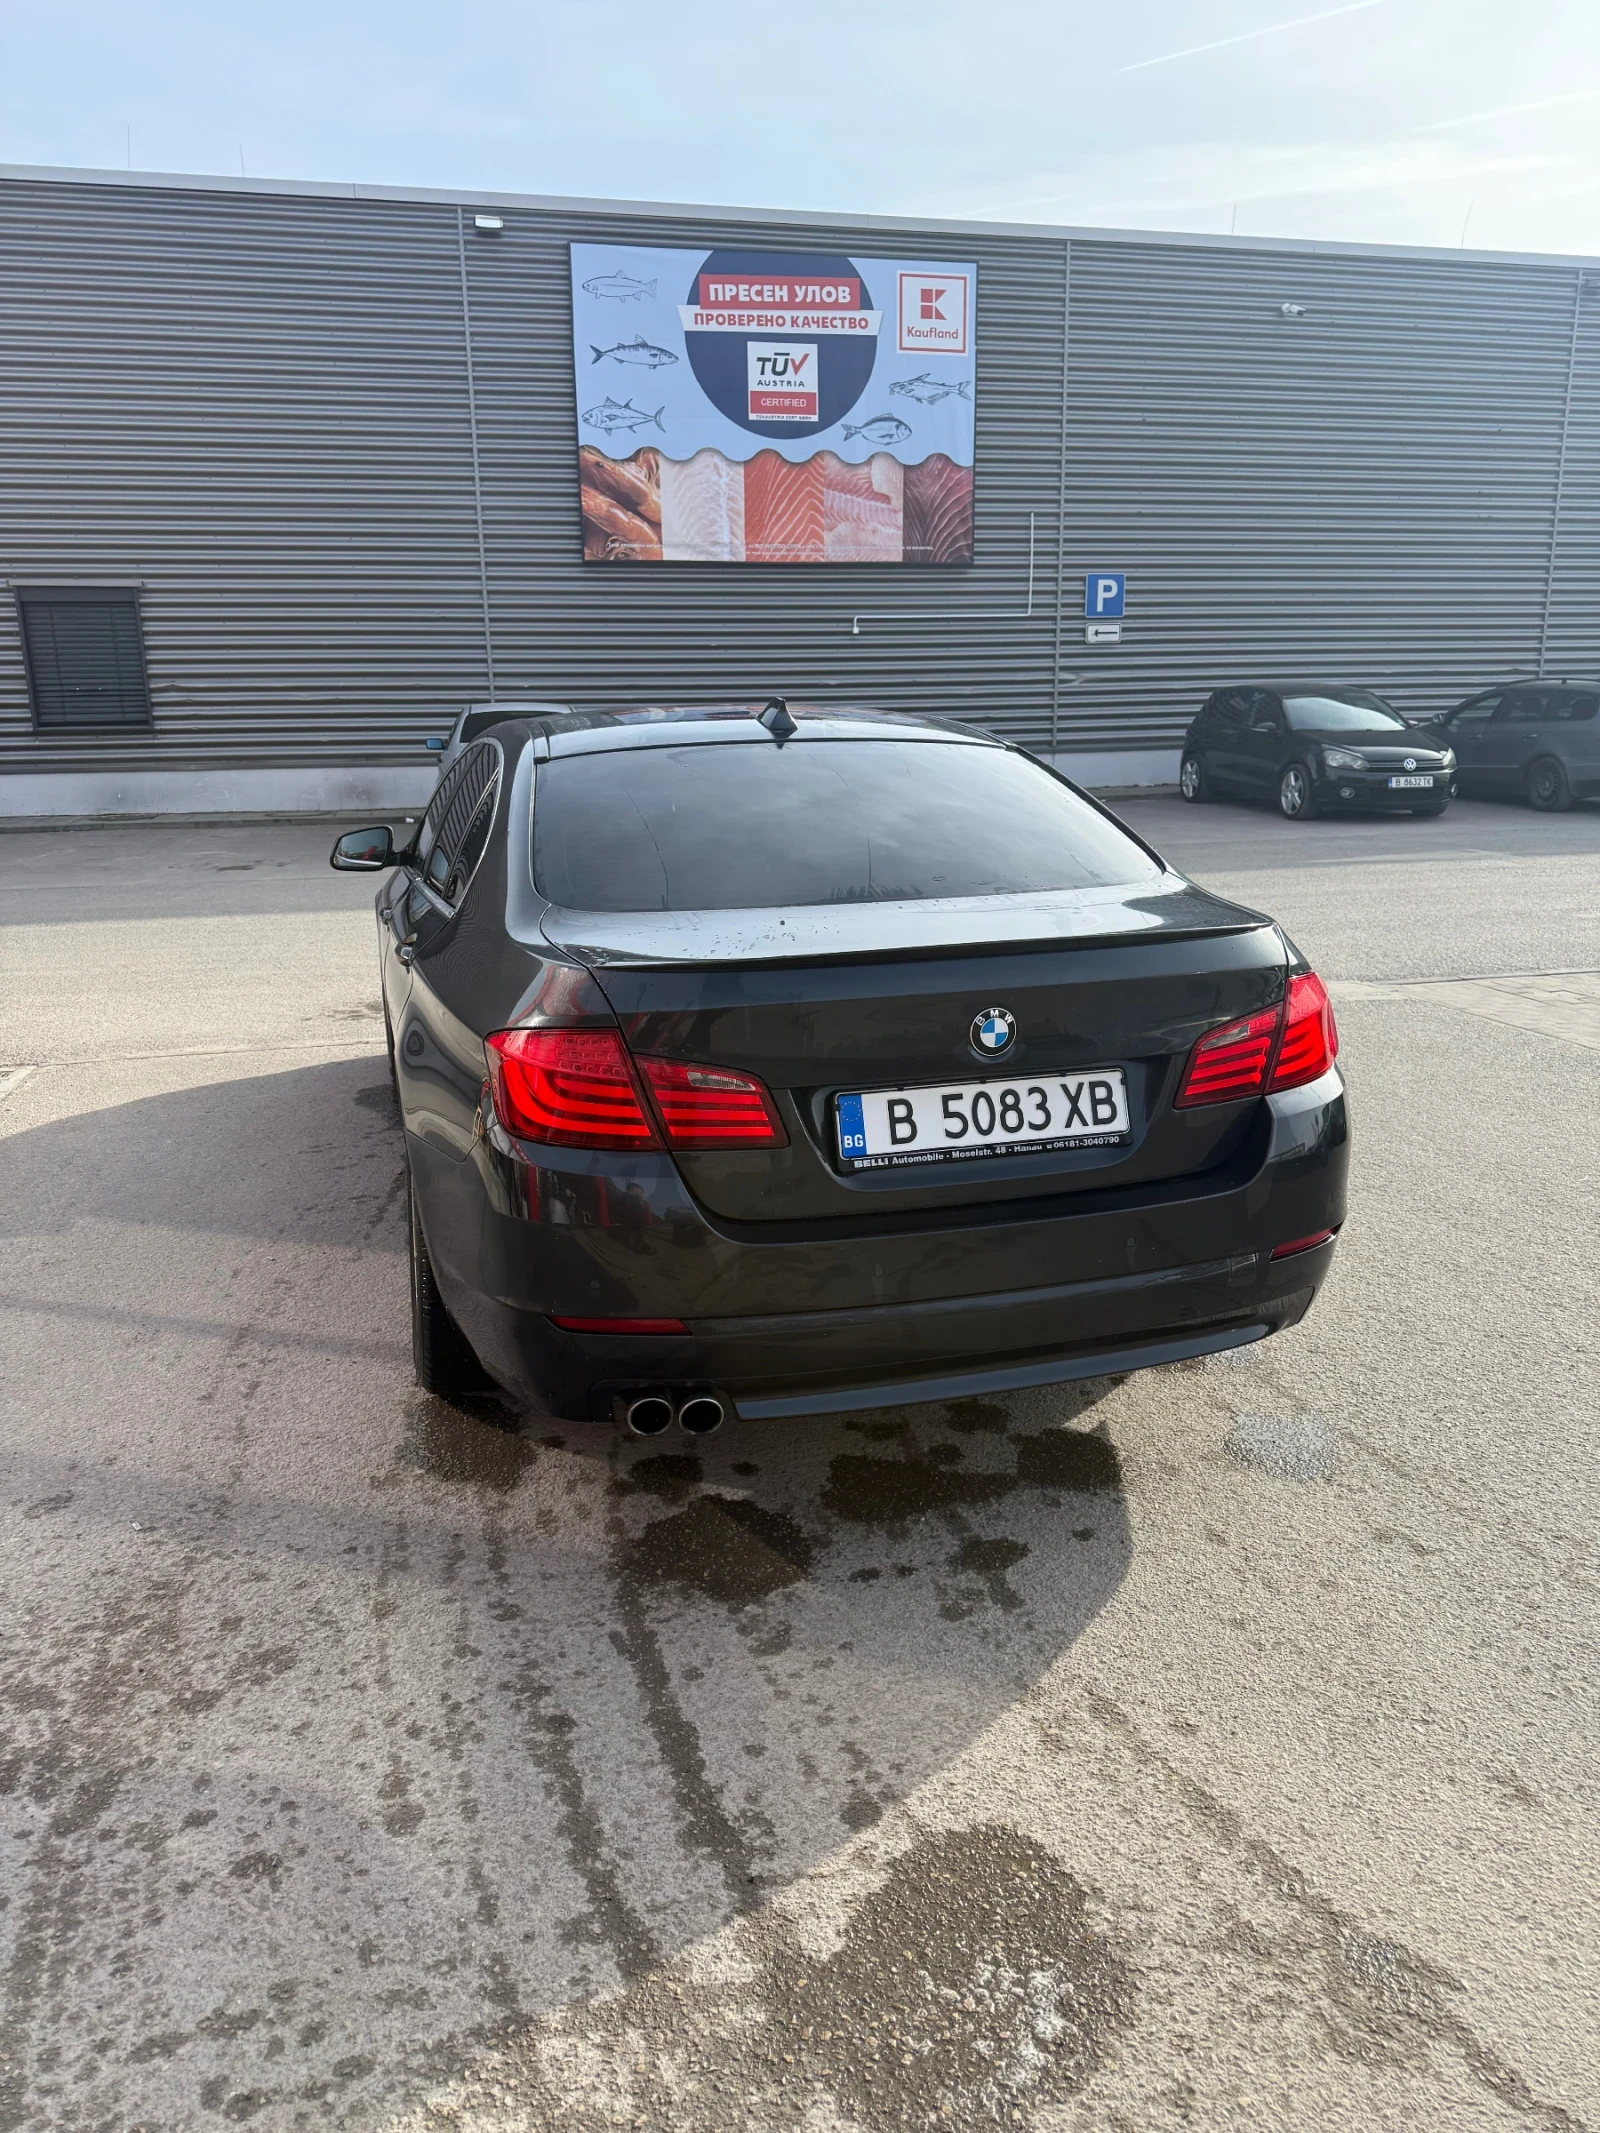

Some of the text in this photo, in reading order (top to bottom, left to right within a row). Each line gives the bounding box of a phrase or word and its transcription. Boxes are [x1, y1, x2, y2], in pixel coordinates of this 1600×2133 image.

[708, 283, 851, 303] ПРЕСЕН УЛОВ
[694, 313, 869, 330] ПРОВЕРЕНО КАЧЕСТВО
[907, 326, 959, 340] Kaufland
[756, 352, 810, 377] TÜV
[757, 379, 805, 388] AUSTRIA
[760, 398, 807, 408] CERTIFIED
[1096, 579, 1118, 612] P
[975, 1009, 1014, 1026] BMW
[887, 1081, 1118, 1145] B 5083 XB
[844, 1134, 864, 1148] BG
[892, 1152, 944, 1165] Automobile
[951, 1148, 993, 1159] Moselstr.
[995, 1147, 1006, 1155] 48
[1014, 1144, 1043, 1153] Hanau
[1053, 1135, 1120, 1149] 06181-3040790
